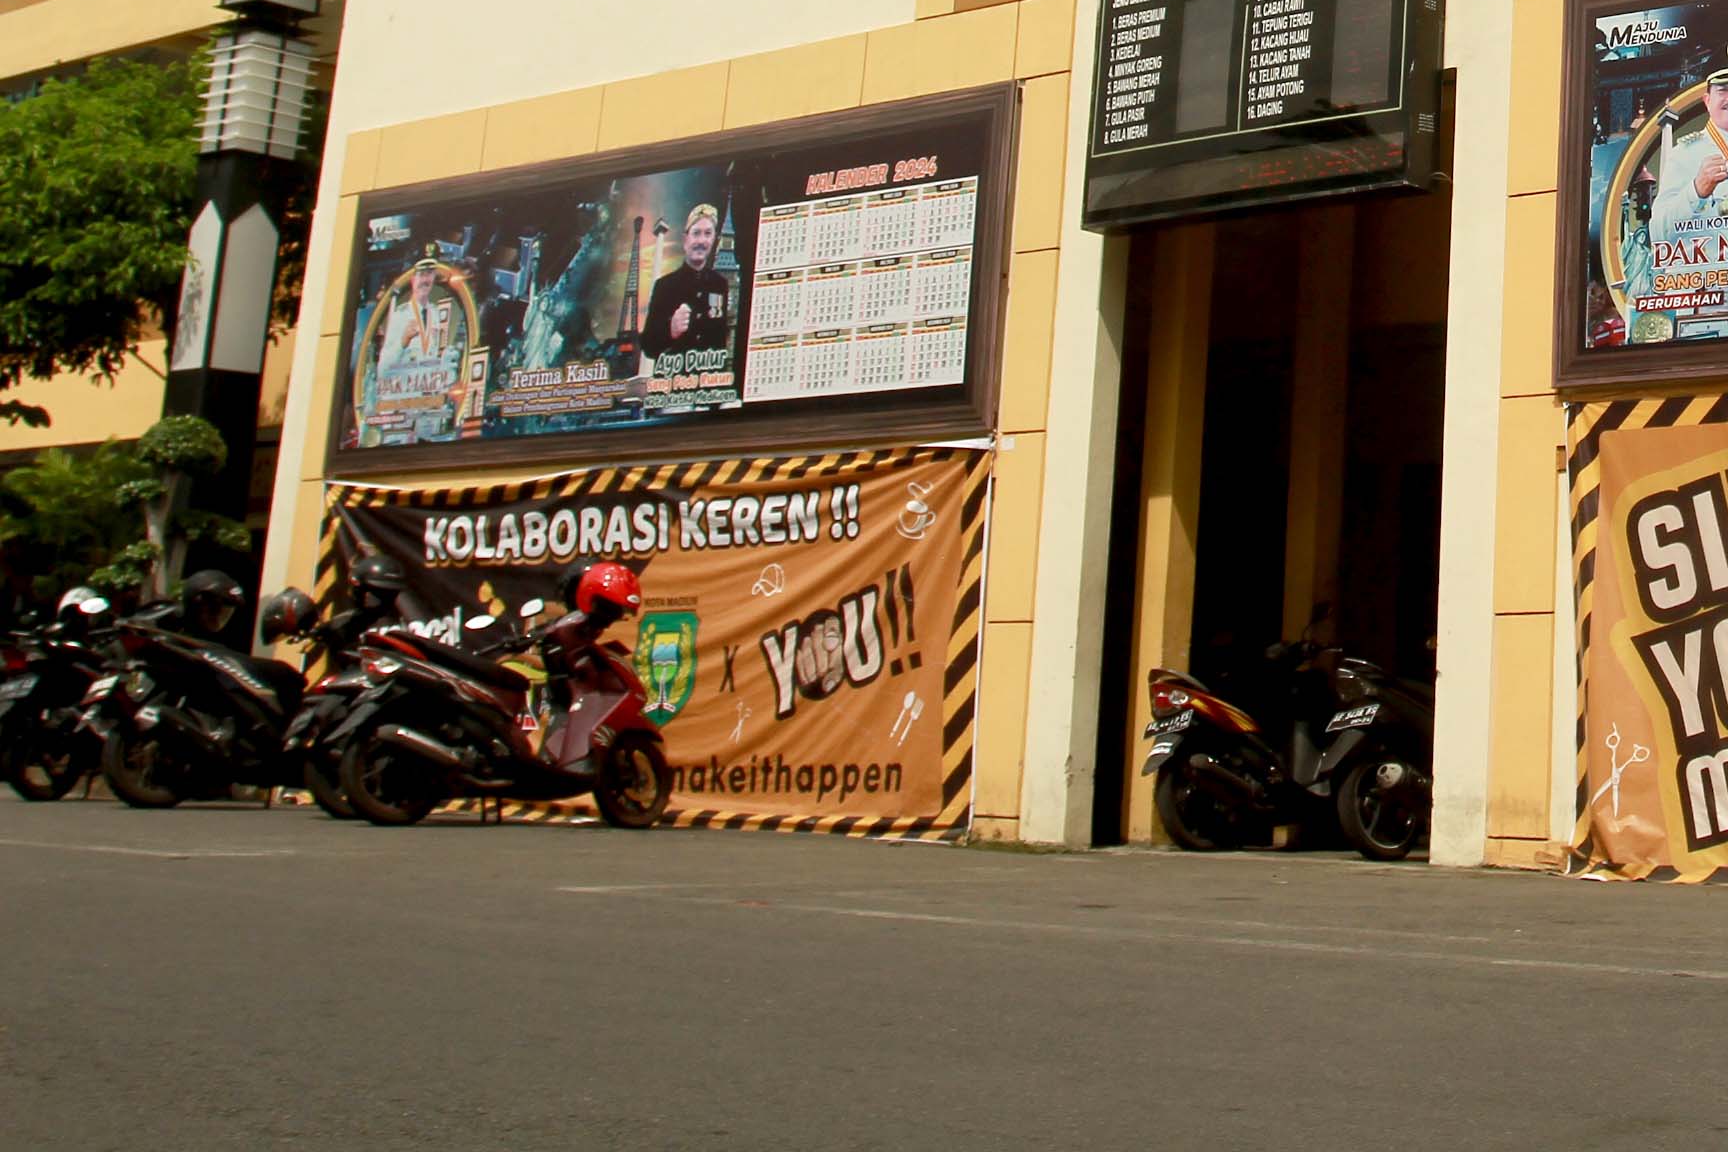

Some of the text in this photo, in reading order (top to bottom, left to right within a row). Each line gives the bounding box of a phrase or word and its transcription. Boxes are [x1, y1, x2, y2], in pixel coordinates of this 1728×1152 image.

[1263, 0, 1285, 17] CABAI
[1117, 13, 1138, 29] BERAS
[1262, 16, 1288, 34] TEPUNG
[1288, 11, 1314, 29] TERIGU
[1117, 29, 1137, 46] BERAS
[1260, 34, 1289, 51] KACANG
[1137, 55, 1163, 73] GORENG
[1259, 50, 1288, 67] KACANG
[1289, 45, 1311, 62] TANAH
[1258, 67, 1280, 84] TELUR
[1280, 63, 1299, 80] AYAM
[1257, 84, 1276, 101] AYAM
[1276, 80, 1305, 98] POTONG
[1110, 111, 1128, 126] GULA
[1128, 107, 1146, 123] PASIR
[1257, 100, 1284, 118] DAGING
[1110, 128, 1127, 143] GULA
[806, 155, 938, 195] KALENDER 2024
[1674, 218, 1703, 233] WALI
[1652, 236, 1712, 269] PAK
[1653, 272, 1703, 292] SANG
[1638, 293, 1722, 311] PERUBAHAN
[654, 352, 684, 376] Ayo
[511, 361, 609, 389] Terima Kasih
[423, 501, 670, 564] KOLABORASI
[679, 490, 823, 550] KEREN
